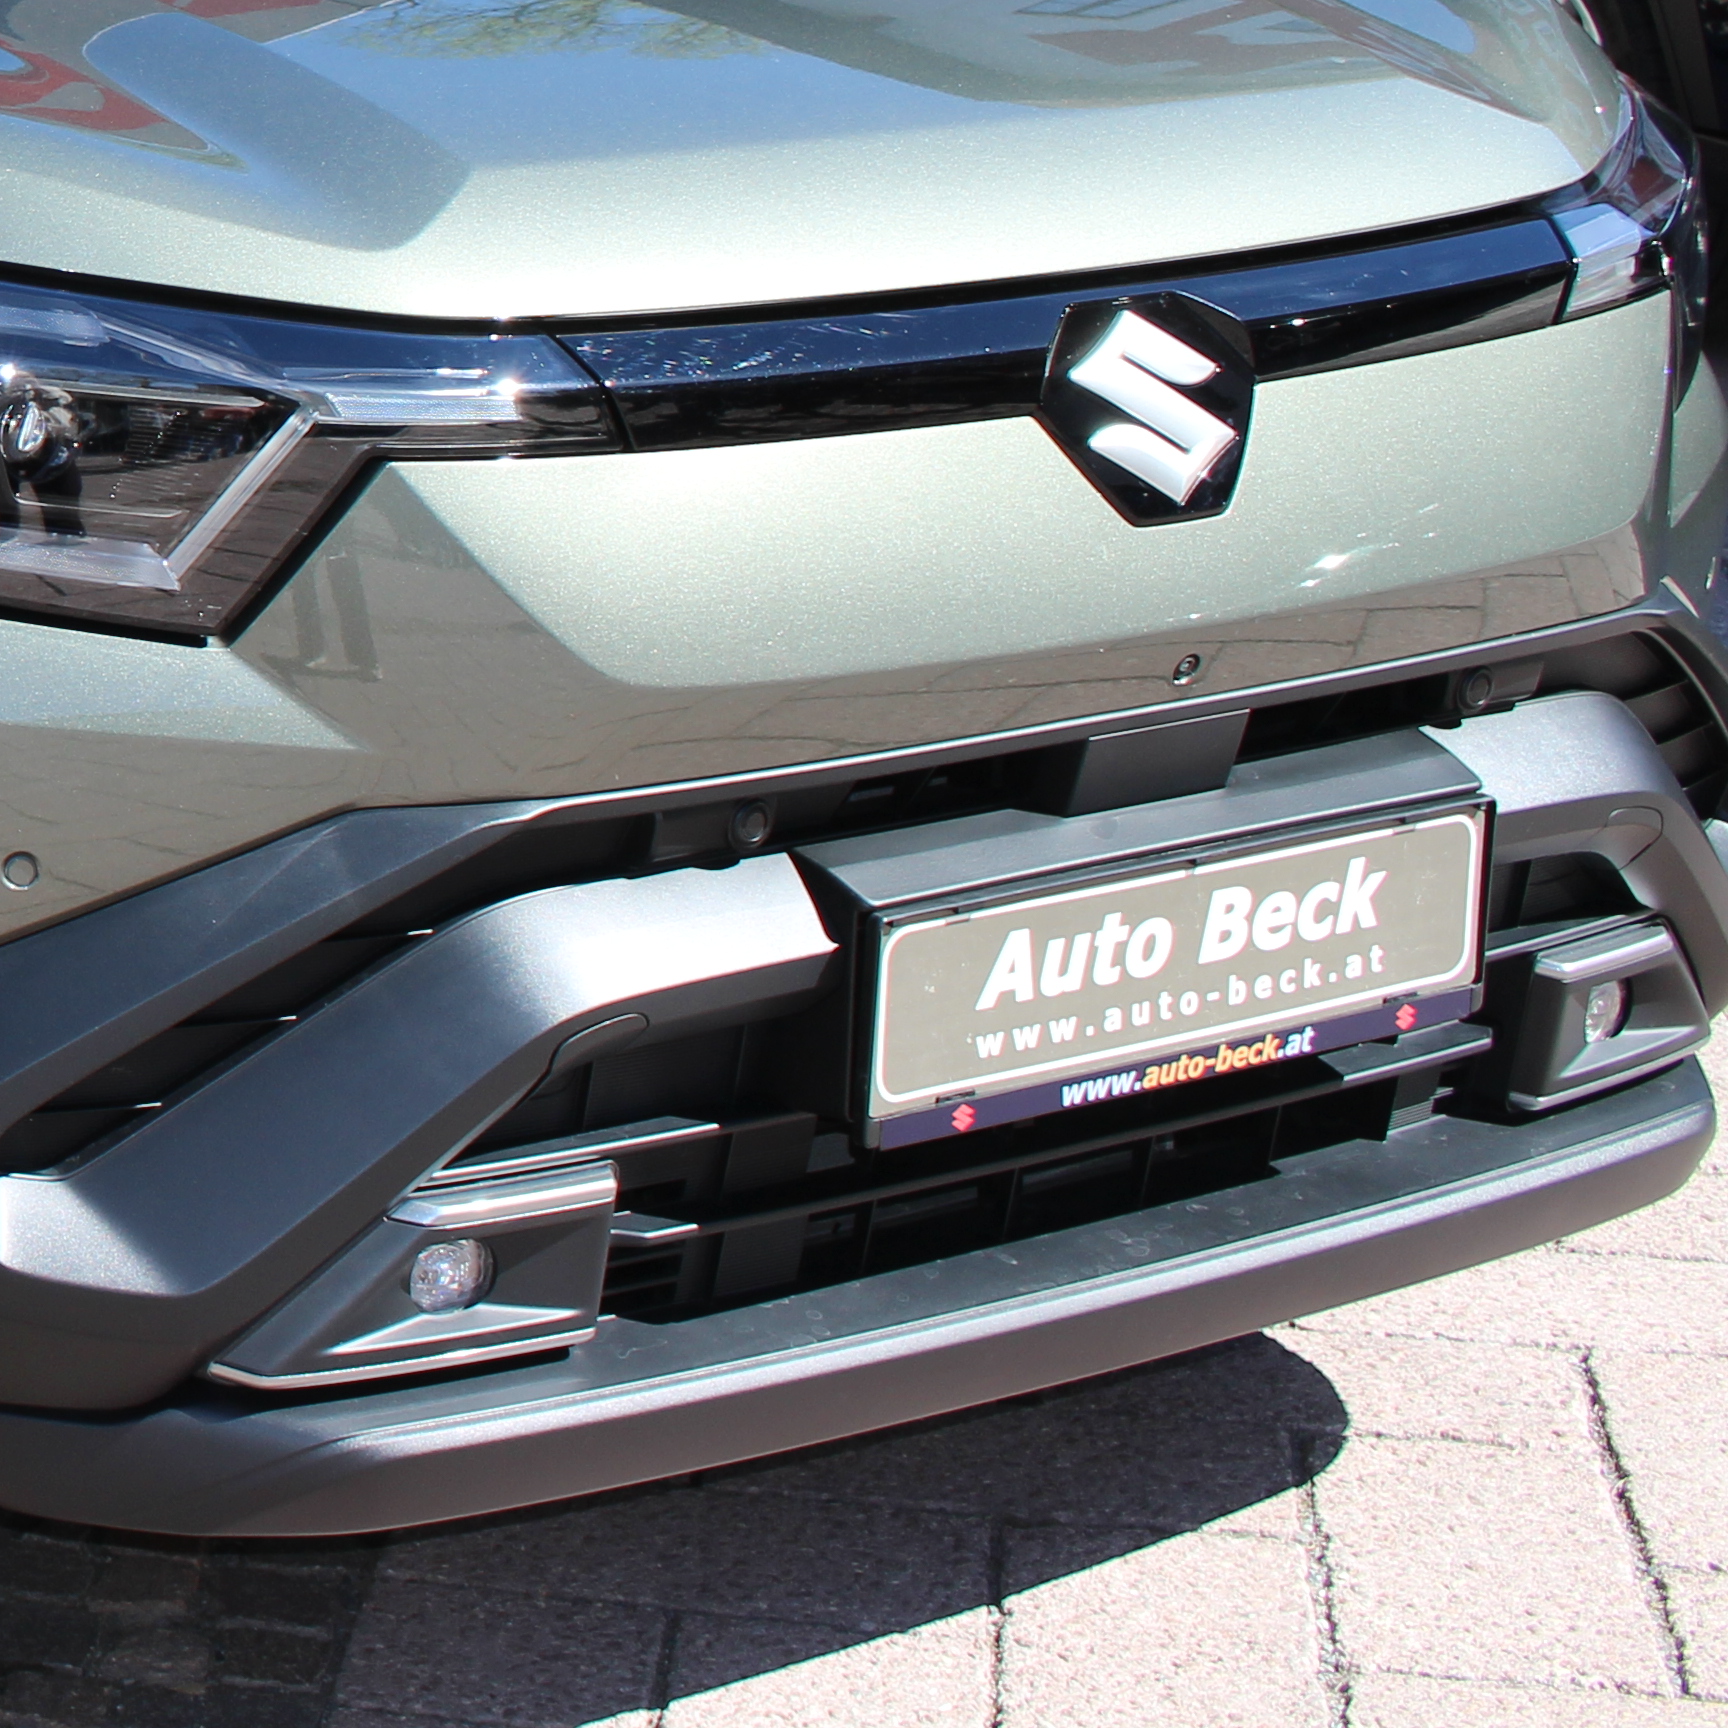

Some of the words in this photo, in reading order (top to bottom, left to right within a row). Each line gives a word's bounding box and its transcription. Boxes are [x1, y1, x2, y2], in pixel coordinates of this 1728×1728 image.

[975, 909, 1174, 1012] Auto
[1197, 855, 1388, 965] Beck
[975, 943, 1386, 1060] www.auto-beck.at
[1059, 1025, 1315, 1109] www.auto-beck.at
